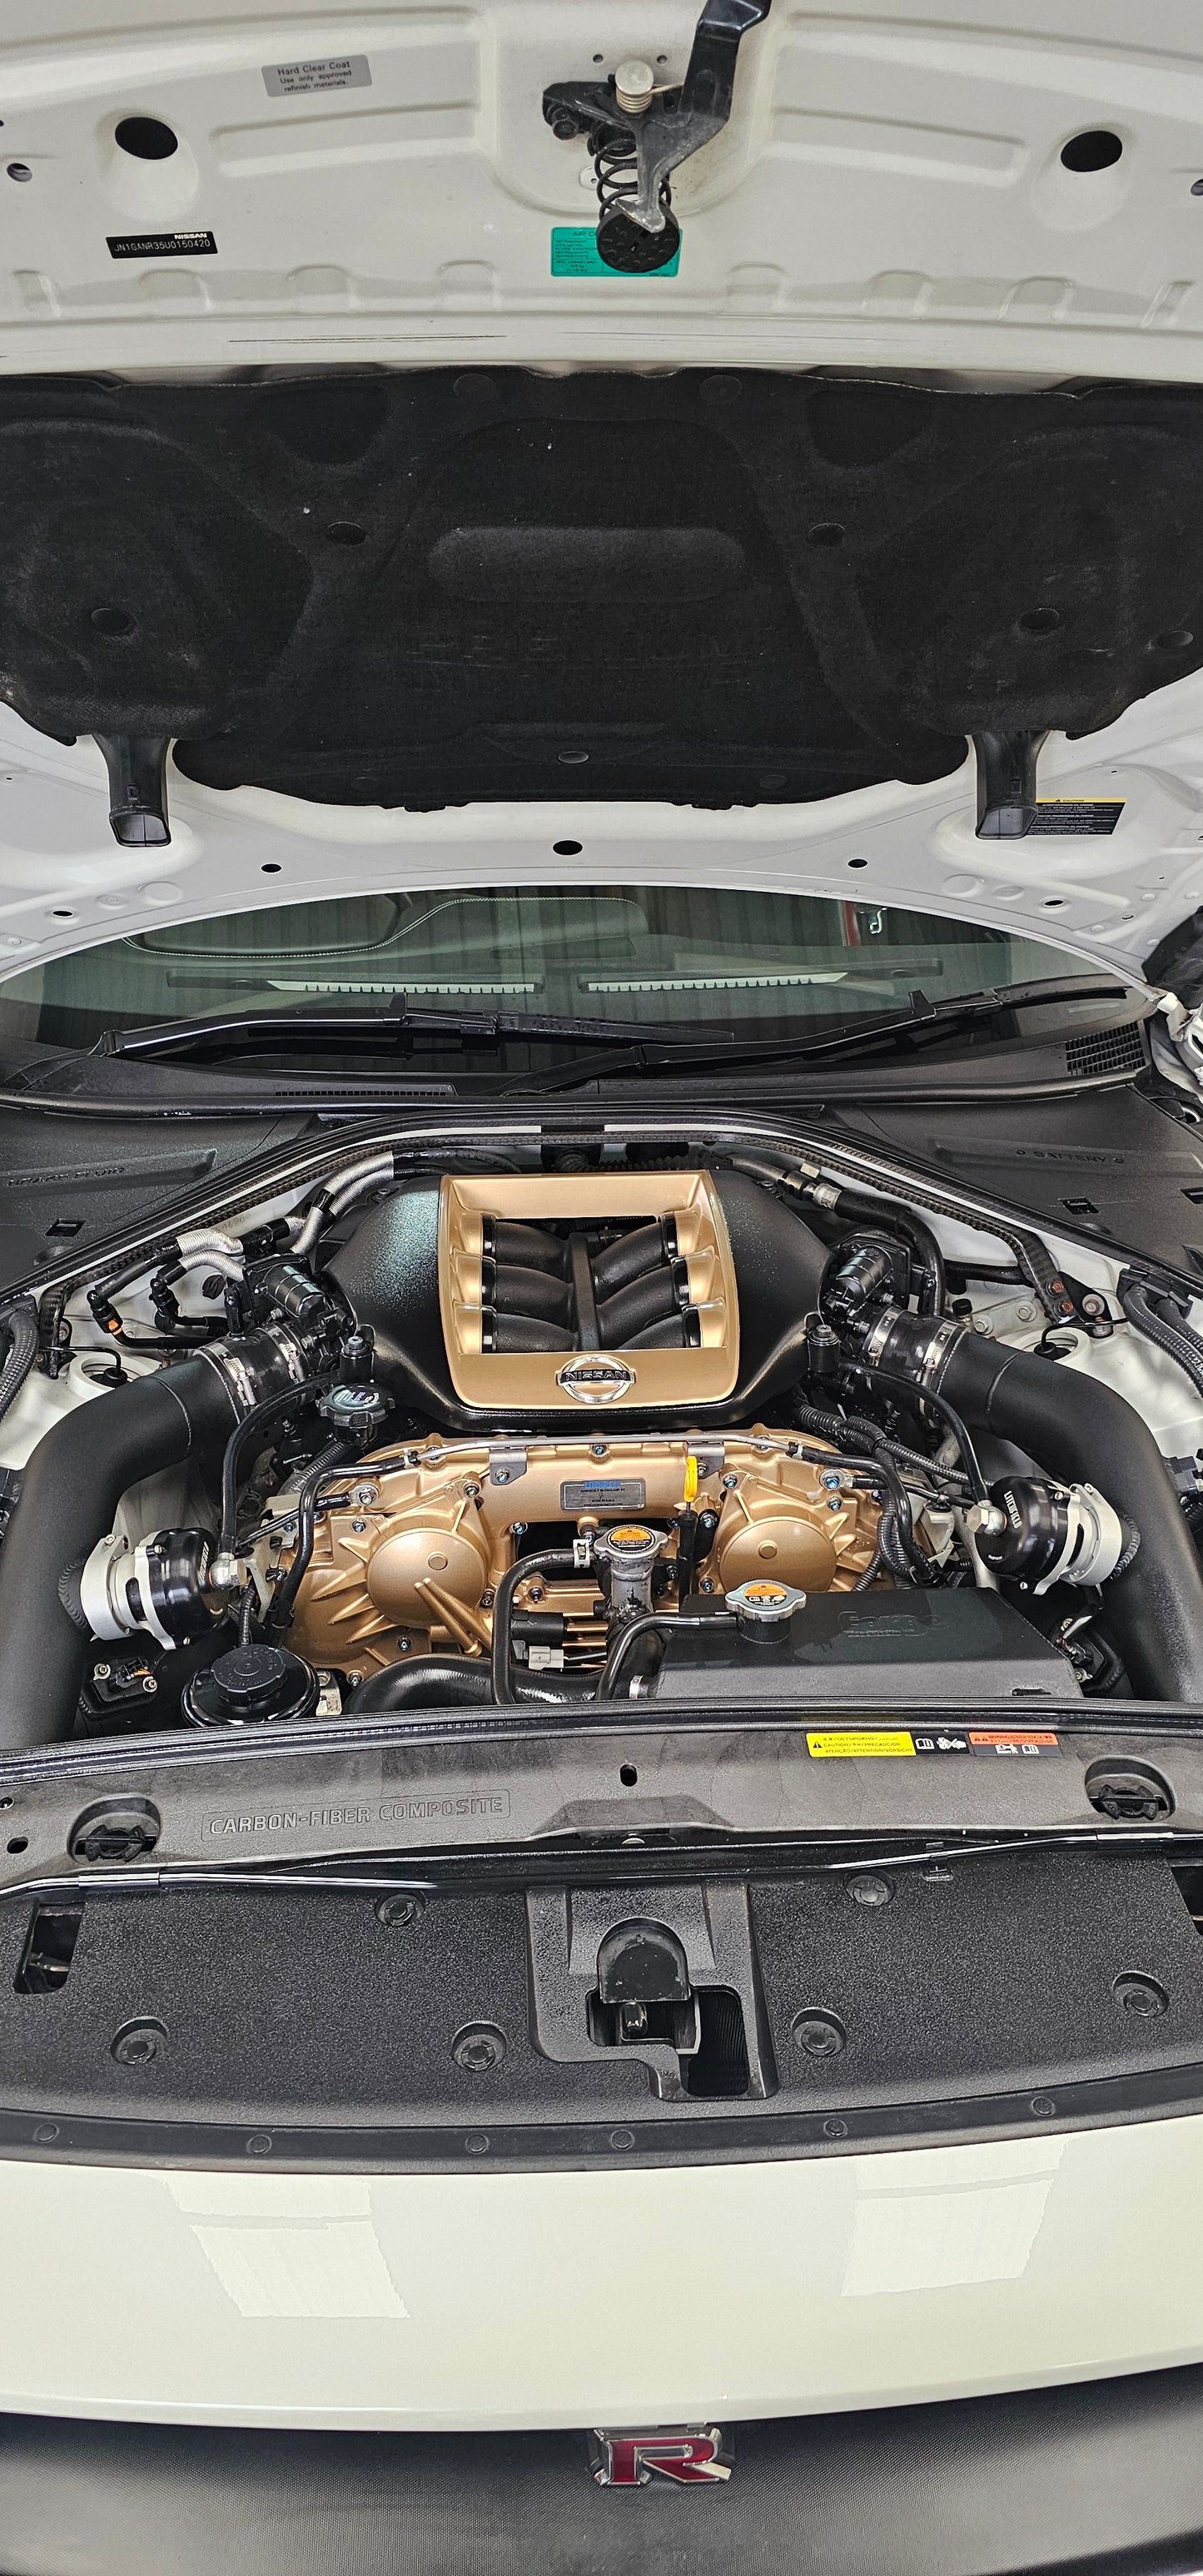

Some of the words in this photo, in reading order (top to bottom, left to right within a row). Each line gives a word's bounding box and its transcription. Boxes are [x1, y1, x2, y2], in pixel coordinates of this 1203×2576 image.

[277, 67, 300, 76] Hard
[302, 64, 326, 72] Clear
[329, 61, 350, 69] Coat
[318, 70, 352, 80] approved
[284, 84, 311, 92] refinish
[314, 80, 349, 88] materials.
[115, 239, 211, 252] JN1GANR35U0150420
[1032, 1151, 1106, 1163] BATTERY
[7, 1172, 70, 1186] BRAKE
[565, 1370, 627, 1381] NISSAN
[210, 1807, 371, 1834] CARBON-FIBER
[378, 1796, 504, 1822] COMPOSITE
[607, 2435, 720, 2485] R
